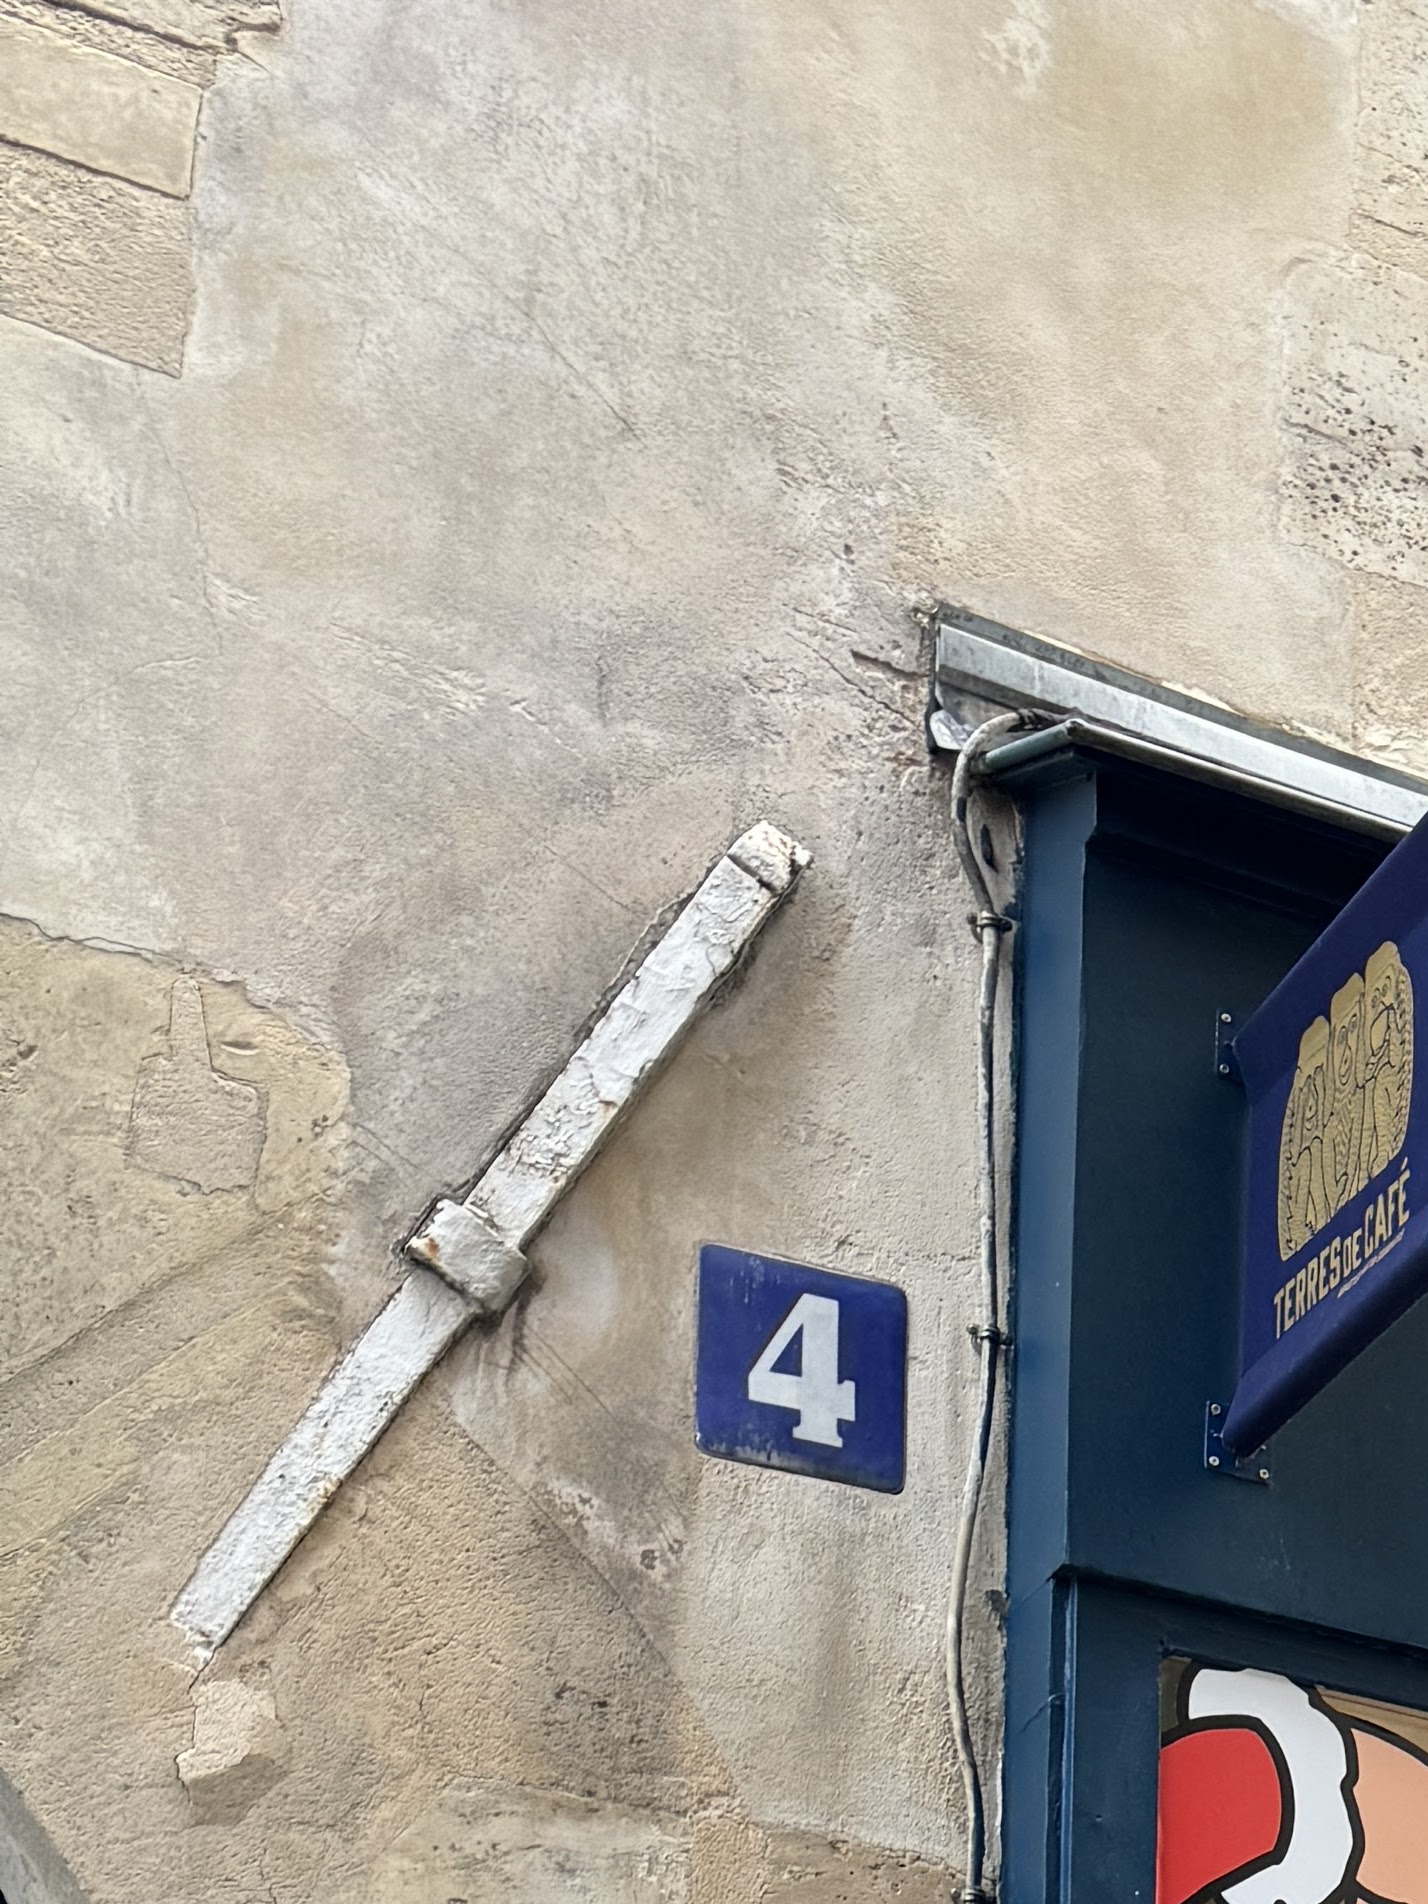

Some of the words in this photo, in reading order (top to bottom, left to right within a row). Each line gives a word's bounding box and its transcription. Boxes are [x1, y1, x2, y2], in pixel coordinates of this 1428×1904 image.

[1273, 1236, 1341, 1340] TERRES
[1342, 1228, 1362, 1278] DE
[1364, 1156, 1411, 1260] CAFÉ
[748, 1292, 855, 1448] 4
